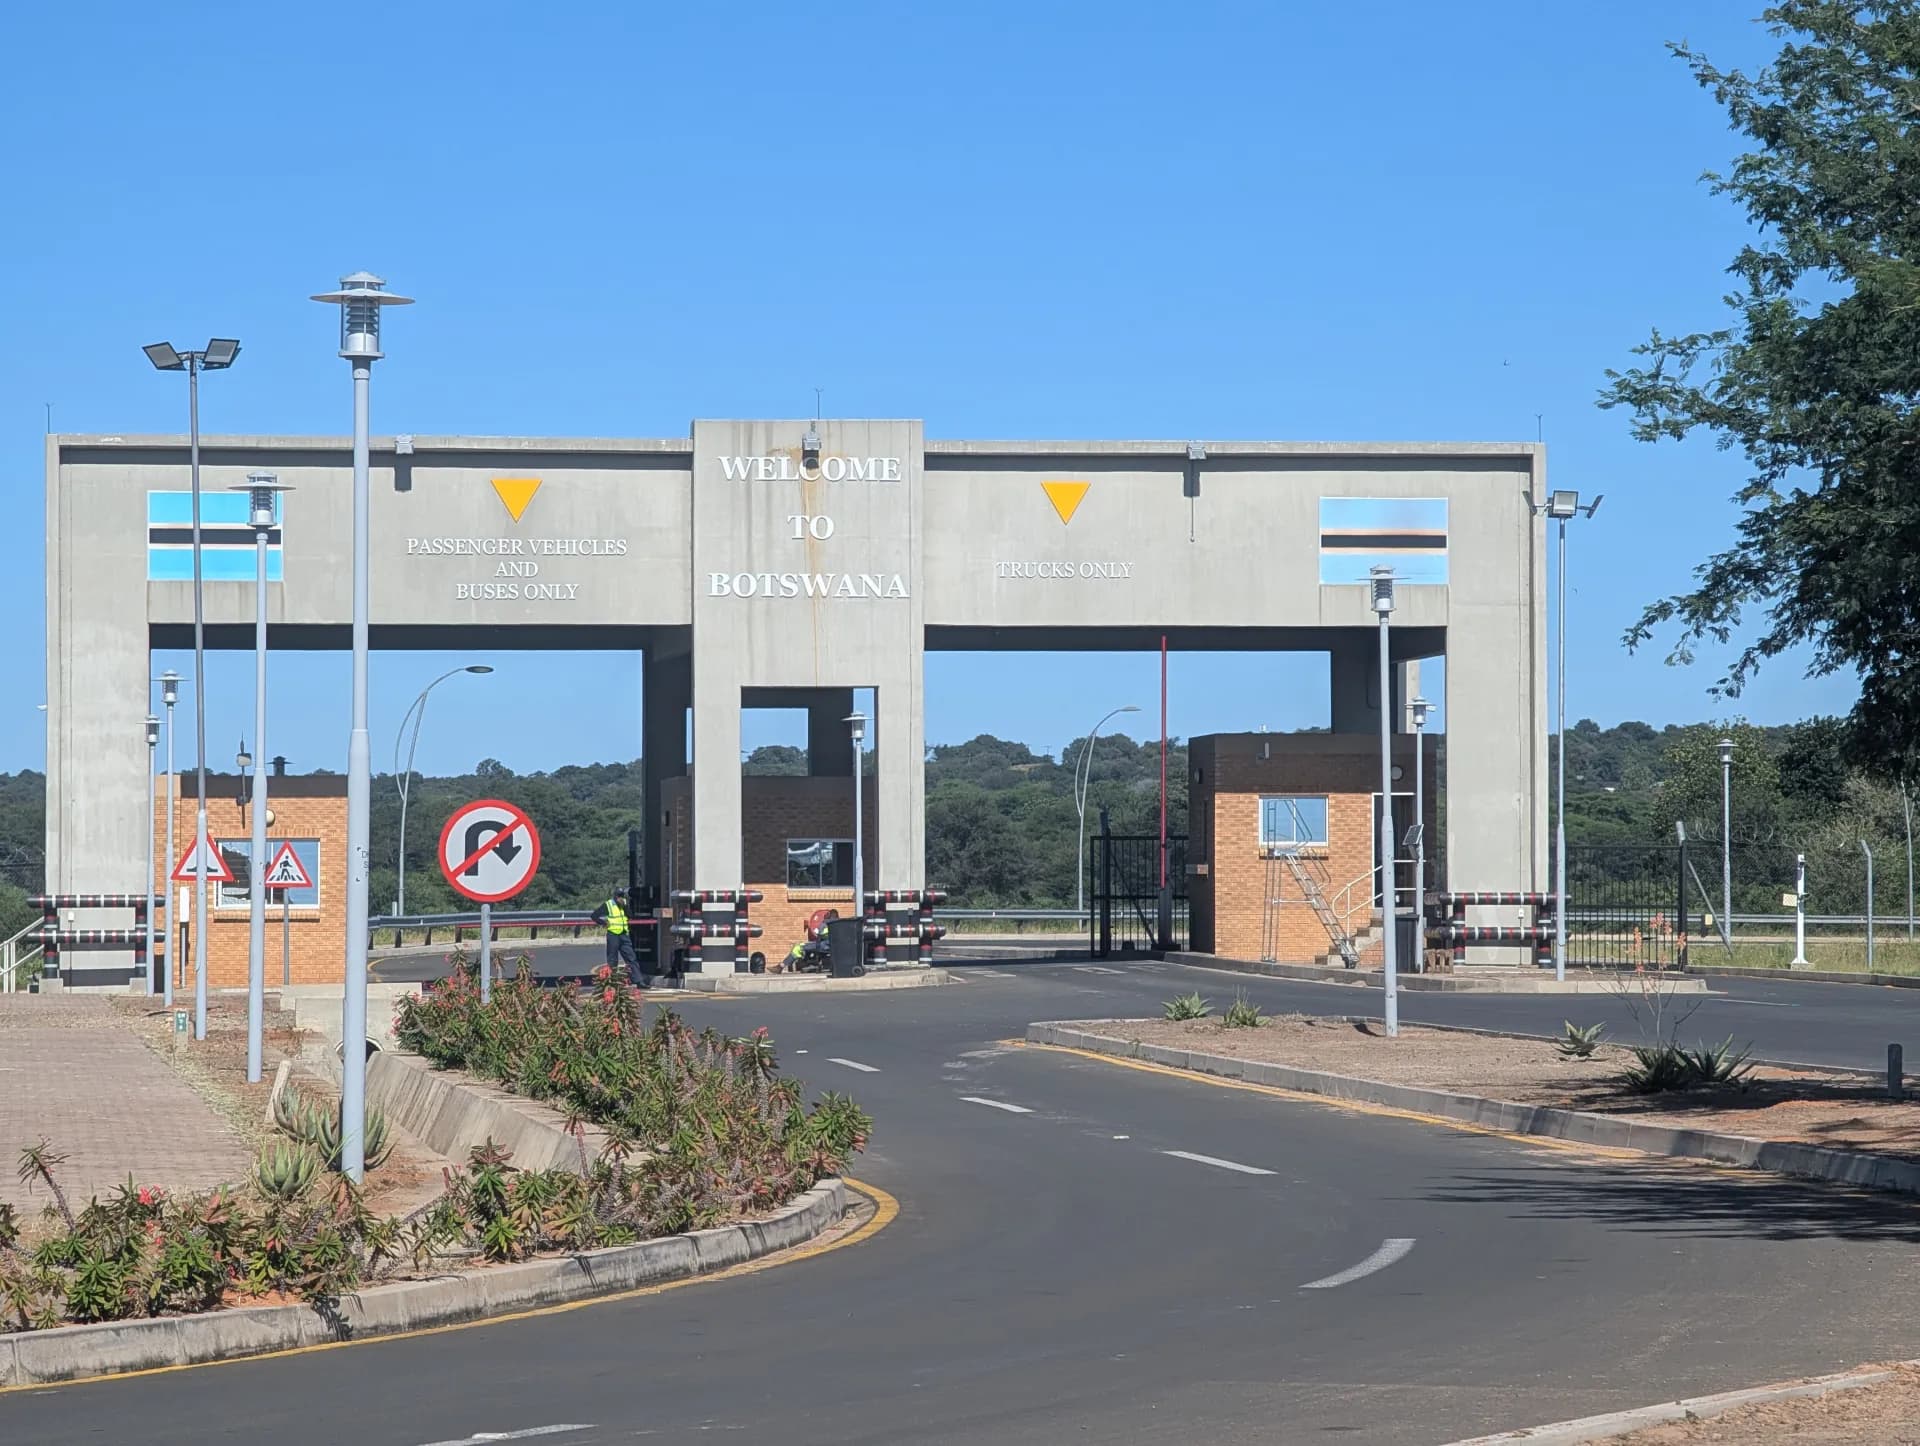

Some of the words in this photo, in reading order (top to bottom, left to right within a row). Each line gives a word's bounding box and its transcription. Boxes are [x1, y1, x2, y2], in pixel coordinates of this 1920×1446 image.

[718, 456, 901, 481] WELCOME
[787, 515, 834, 540] TO
[407, 538, 523, 555] PASSENGER
[527, 539, 628, 555] VEHICLES
[495, 561, 539, 577] AND
[996, 561, 1075, 578] TRUCKS
[1079, 561, 1134, 578] ONLY
[456, 584, 518, 600] BUSES
[524, 584, 579, 600] ONLY
[708, 572, 910, 598] BOTSWANA
